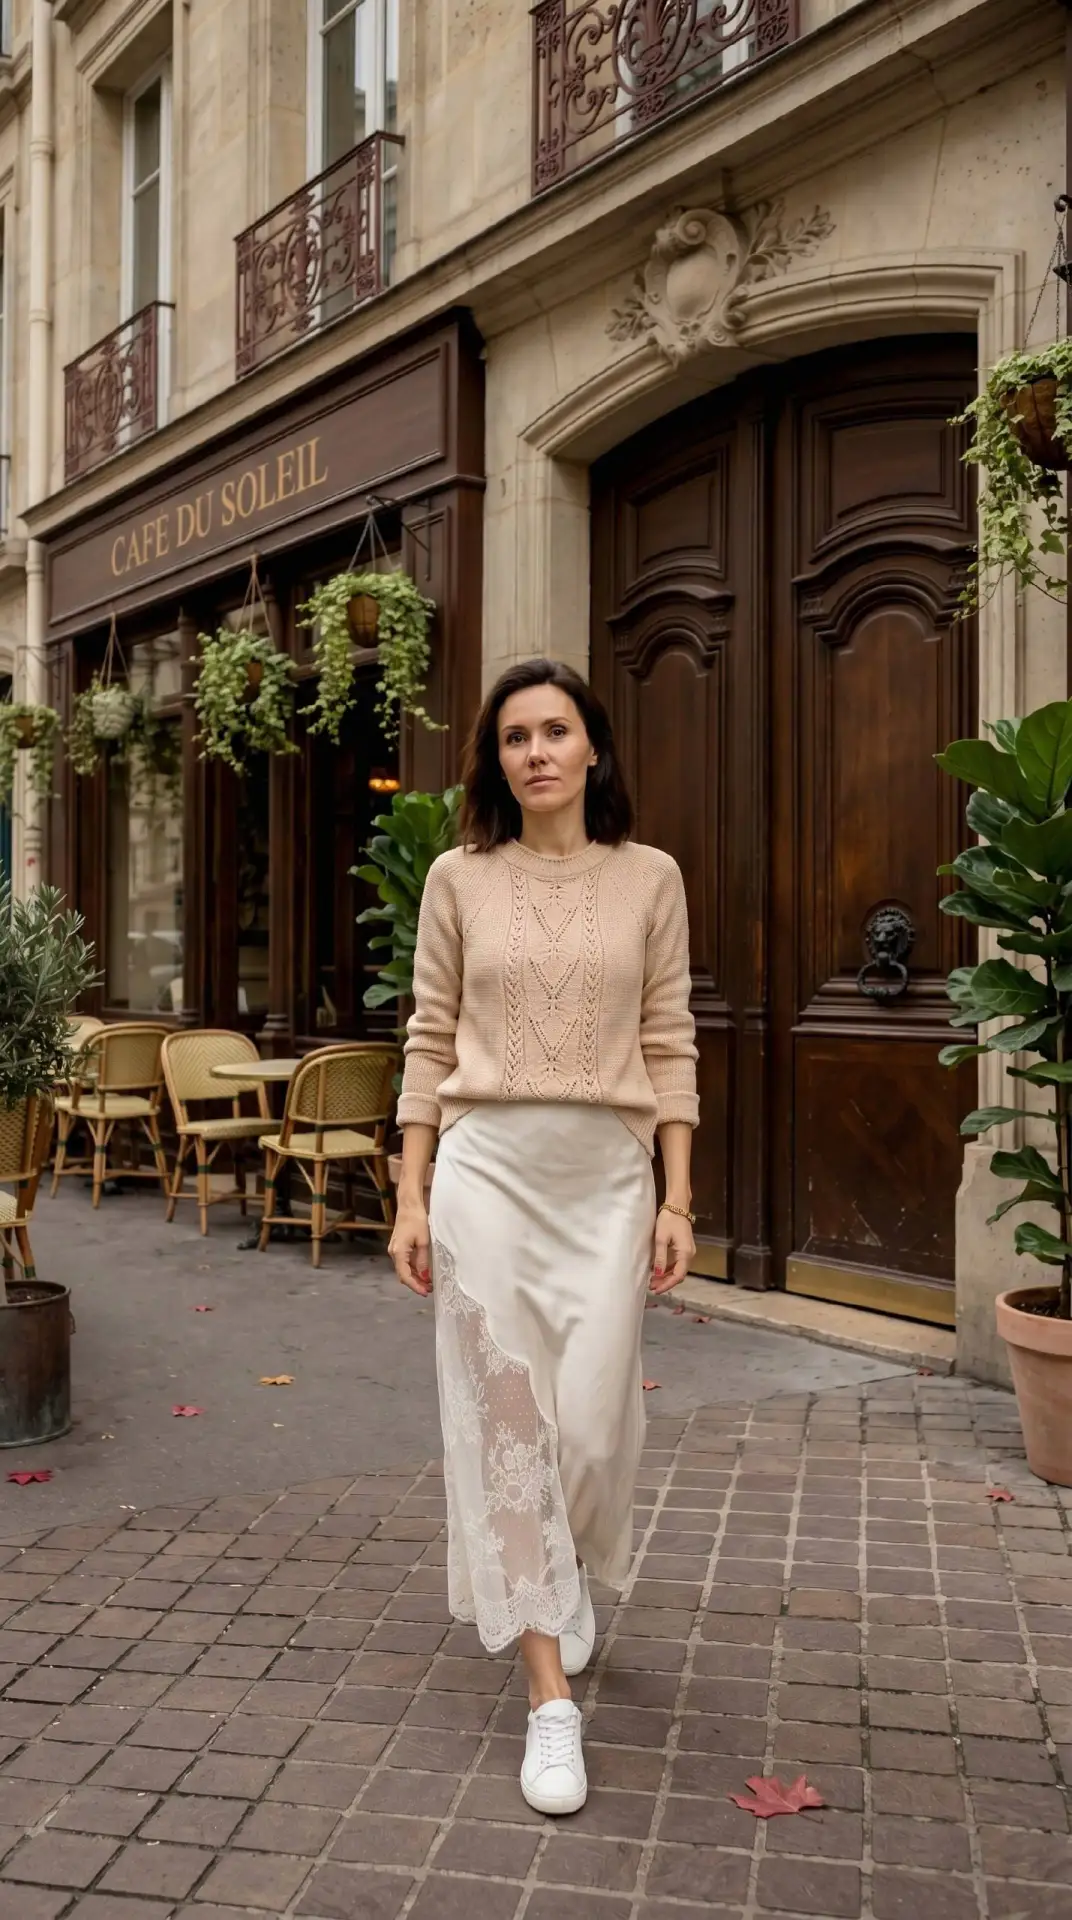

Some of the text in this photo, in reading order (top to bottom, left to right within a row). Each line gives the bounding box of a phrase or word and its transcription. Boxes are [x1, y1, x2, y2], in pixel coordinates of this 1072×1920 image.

[111, 437, 329, 576] CAFÉ DU SOLEIL
